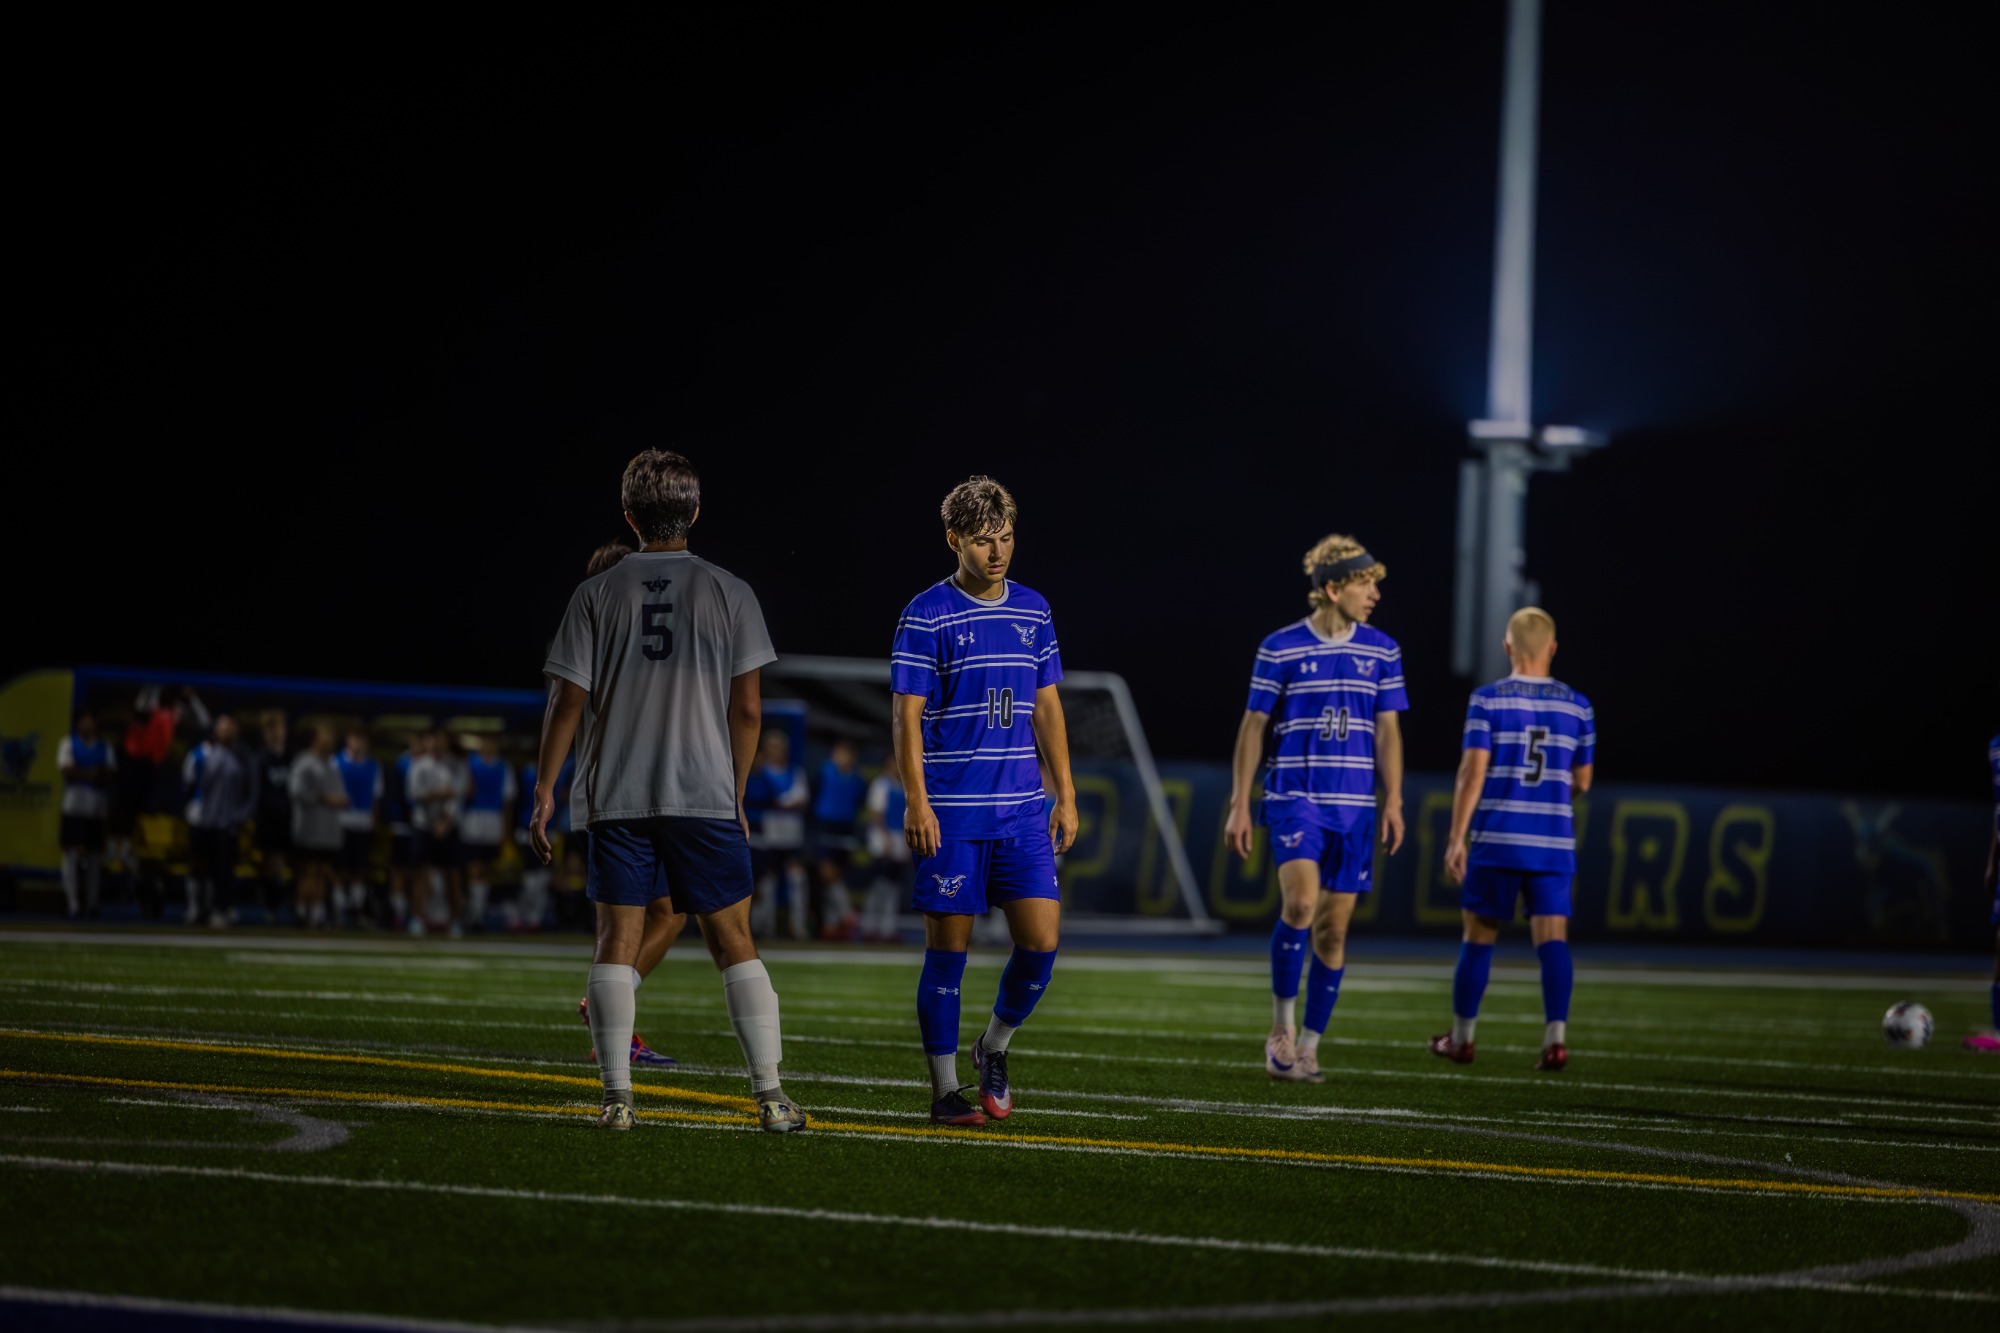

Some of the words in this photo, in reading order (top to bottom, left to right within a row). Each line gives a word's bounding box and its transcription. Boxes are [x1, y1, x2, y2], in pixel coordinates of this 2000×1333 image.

[642, 603, 673, 661] 5
[987, 688, 1013, 729] 10
[1319, 705, 1351, 742] 30
[1519, 724, 1551, 788] 5
